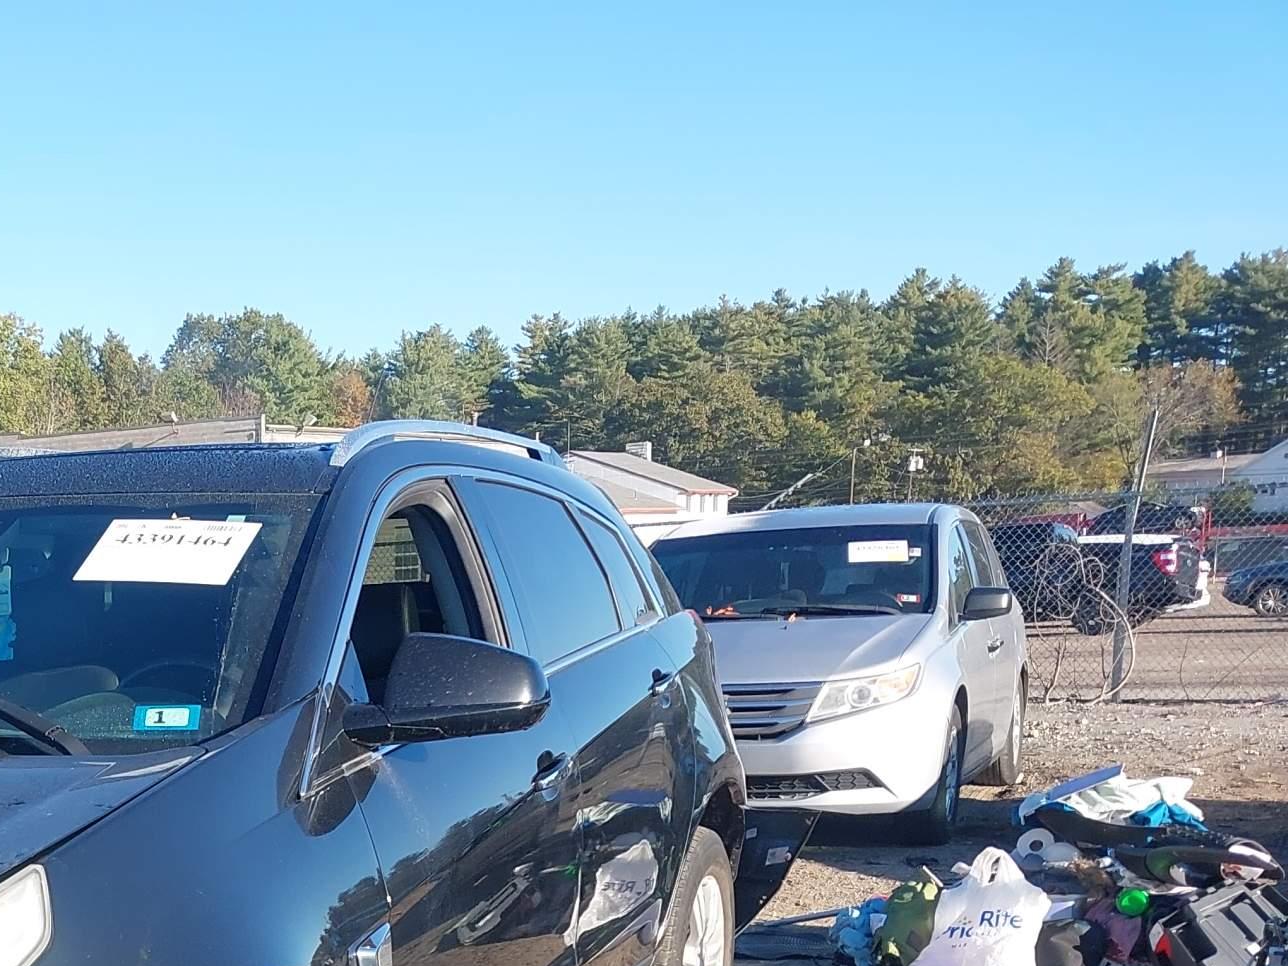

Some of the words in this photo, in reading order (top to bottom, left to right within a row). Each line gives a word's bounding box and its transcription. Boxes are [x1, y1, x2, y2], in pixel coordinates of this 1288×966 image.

[115, 533, 233, 546] 43391464
[153, 711, 165, 723] 1
[979, 909, 1022, 928] Rite
